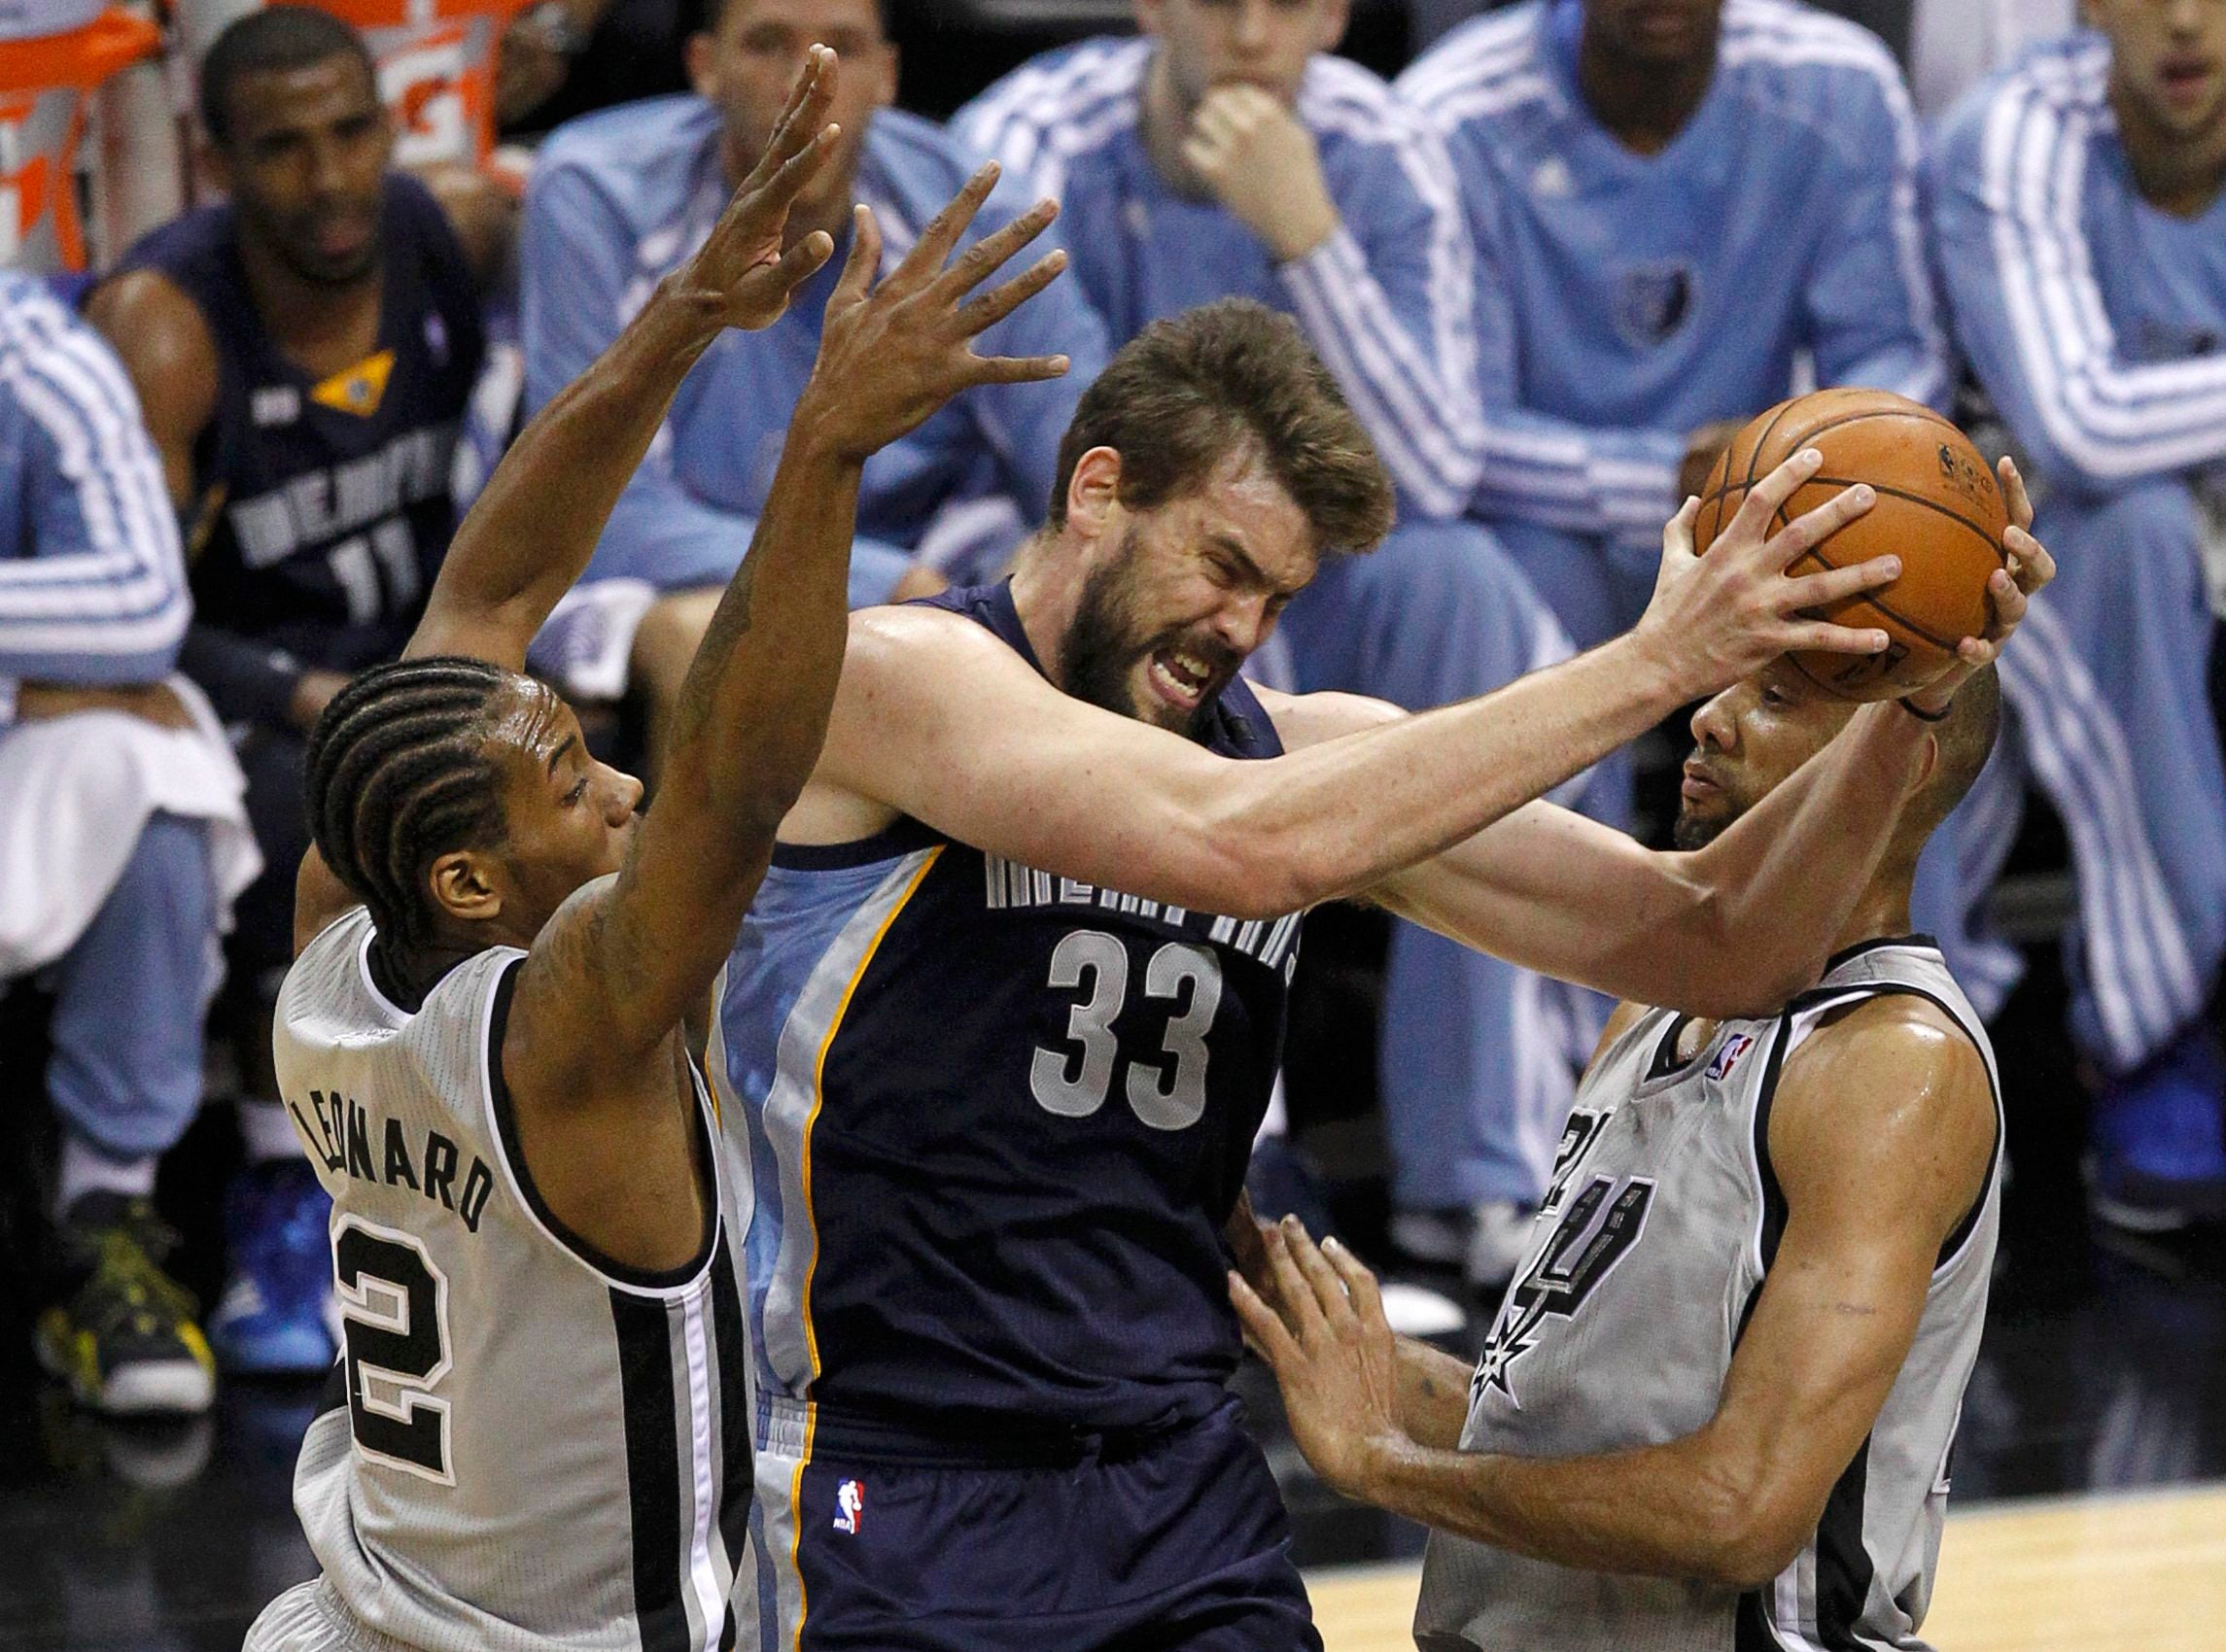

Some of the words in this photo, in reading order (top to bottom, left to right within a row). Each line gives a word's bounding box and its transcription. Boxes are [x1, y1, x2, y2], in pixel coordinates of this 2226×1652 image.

[328, 513, 421, 625] 11
[1029, 929, 1222, 1131] 33
[291, 1090, 493, 1233] LEONARD
[331, 1213, 457, 1487] 2
